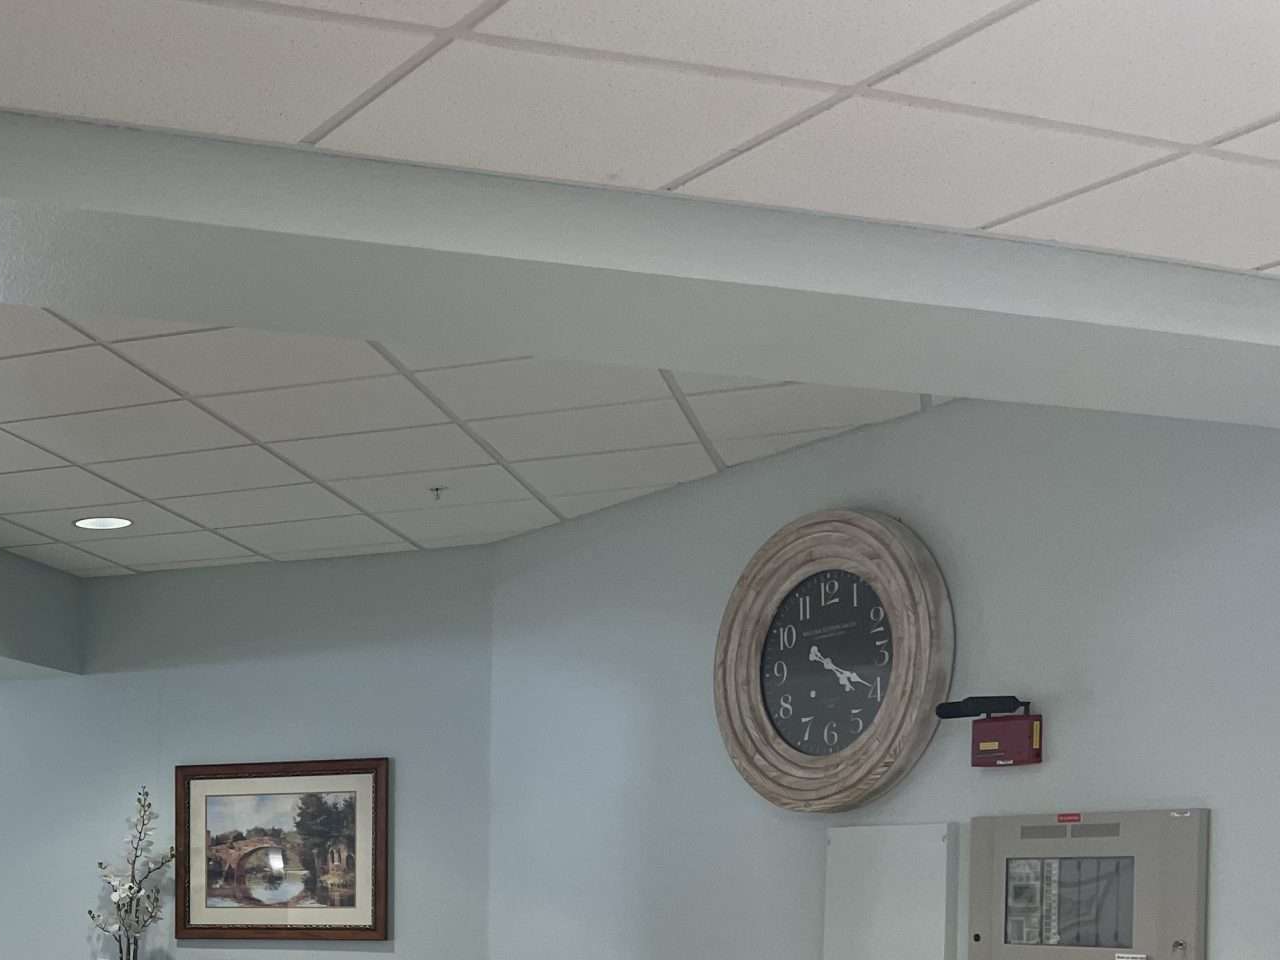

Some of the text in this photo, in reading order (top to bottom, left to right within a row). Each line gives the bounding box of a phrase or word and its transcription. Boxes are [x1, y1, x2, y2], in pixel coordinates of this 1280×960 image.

[821, 580, 840, 607] 12
[853, 583, 858, 608] 1
[799, 595, 811, 621] 11
[870, 606, 885, 634] 2
[780, 624, 797, 652] 10
[875, 639, 890, 667] 3
[774, 660, 788, 686] 9
[867, 676, 882, 702] 4
[780, 694, 793, 719] 8
[801, 716, 816, 741] 7
[823, 721, 839, 746] 6
[850, 708, 864, 735] 5
